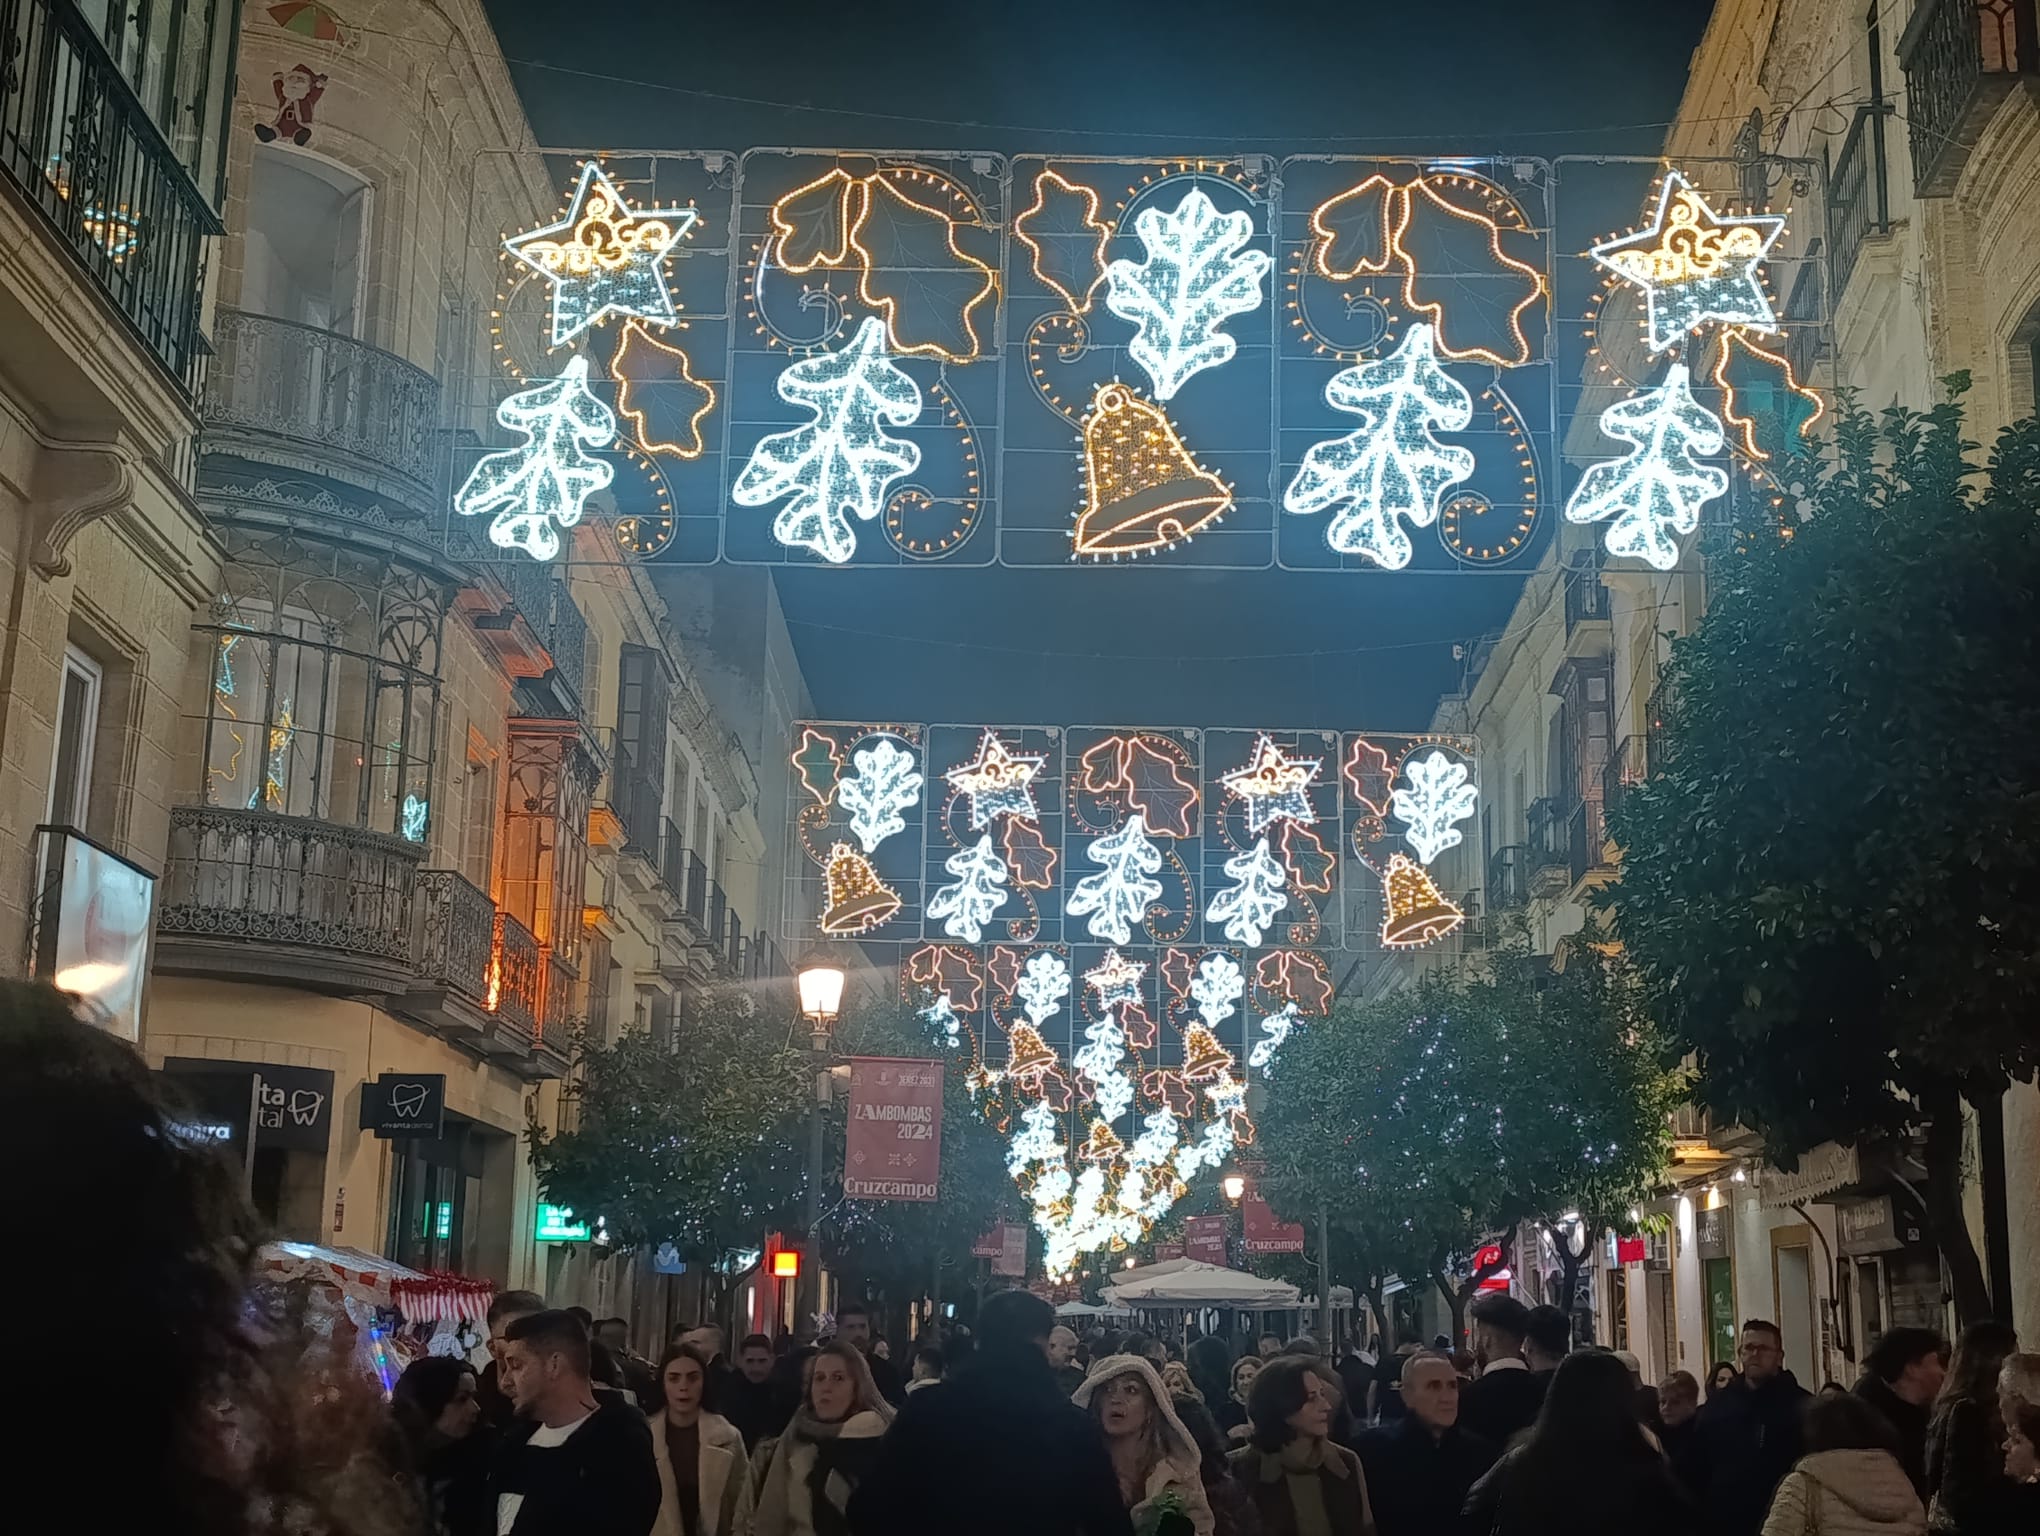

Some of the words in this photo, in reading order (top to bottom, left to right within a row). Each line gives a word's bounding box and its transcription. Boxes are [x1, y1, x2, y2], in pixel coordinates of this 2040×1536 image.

[259, 1083, 285, 1106] ta
[258, 1107, 285, 1128] tal
[855, 1104, 932, 1122] ZAMBOMBAS
[897, 1123, 933, 1140] 2024
[843, 1176, 938, 1199] Cruzcampo
[1245, 1239, 1304, 1251] Cruzcampo
